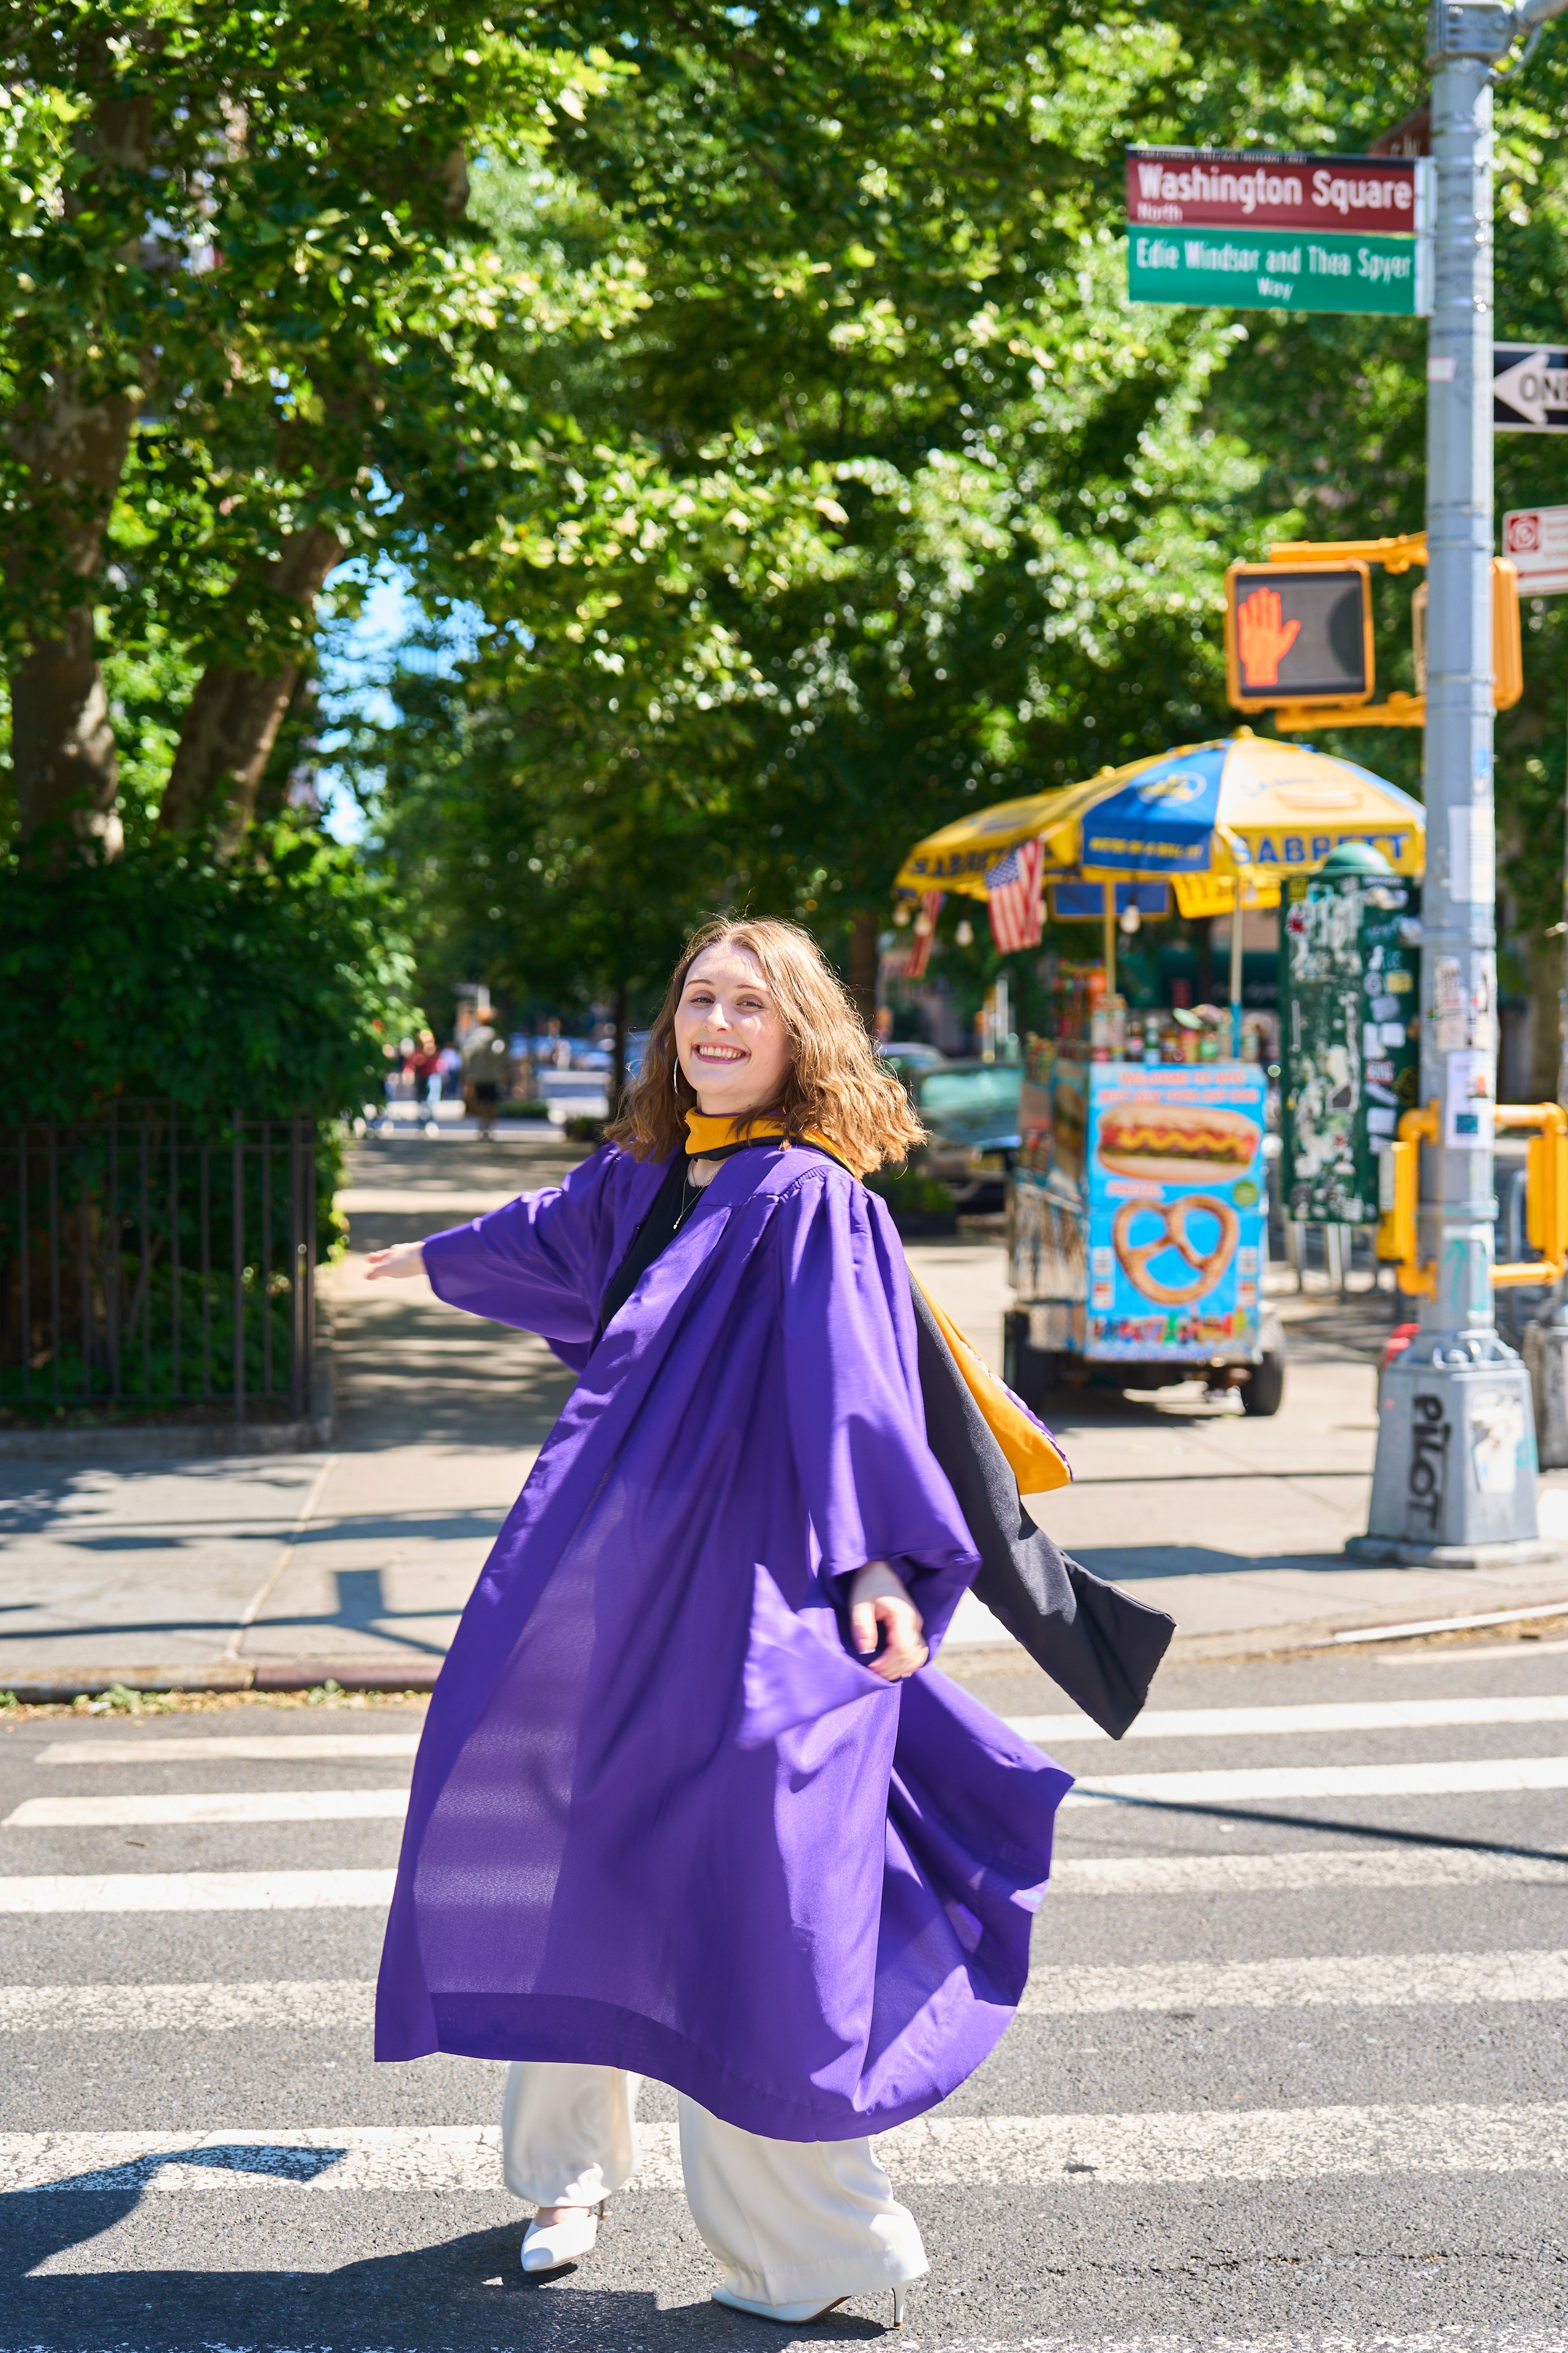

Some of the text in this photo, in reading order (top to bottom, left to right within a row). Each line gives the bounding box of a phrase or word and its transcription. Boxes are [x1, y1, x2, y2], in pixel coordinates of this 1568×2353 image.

[1137, 163, 1413, 214] Washington Square
[1137, 202, 1183, 222] North
[1137, 238, 1412, 284] Edie Windsor and Thea Spyer
[1257, 277, 1294, 301] Way
[1519, 372, 1568, 402] ON
[1230, 833, 1409, 864] SABRT
